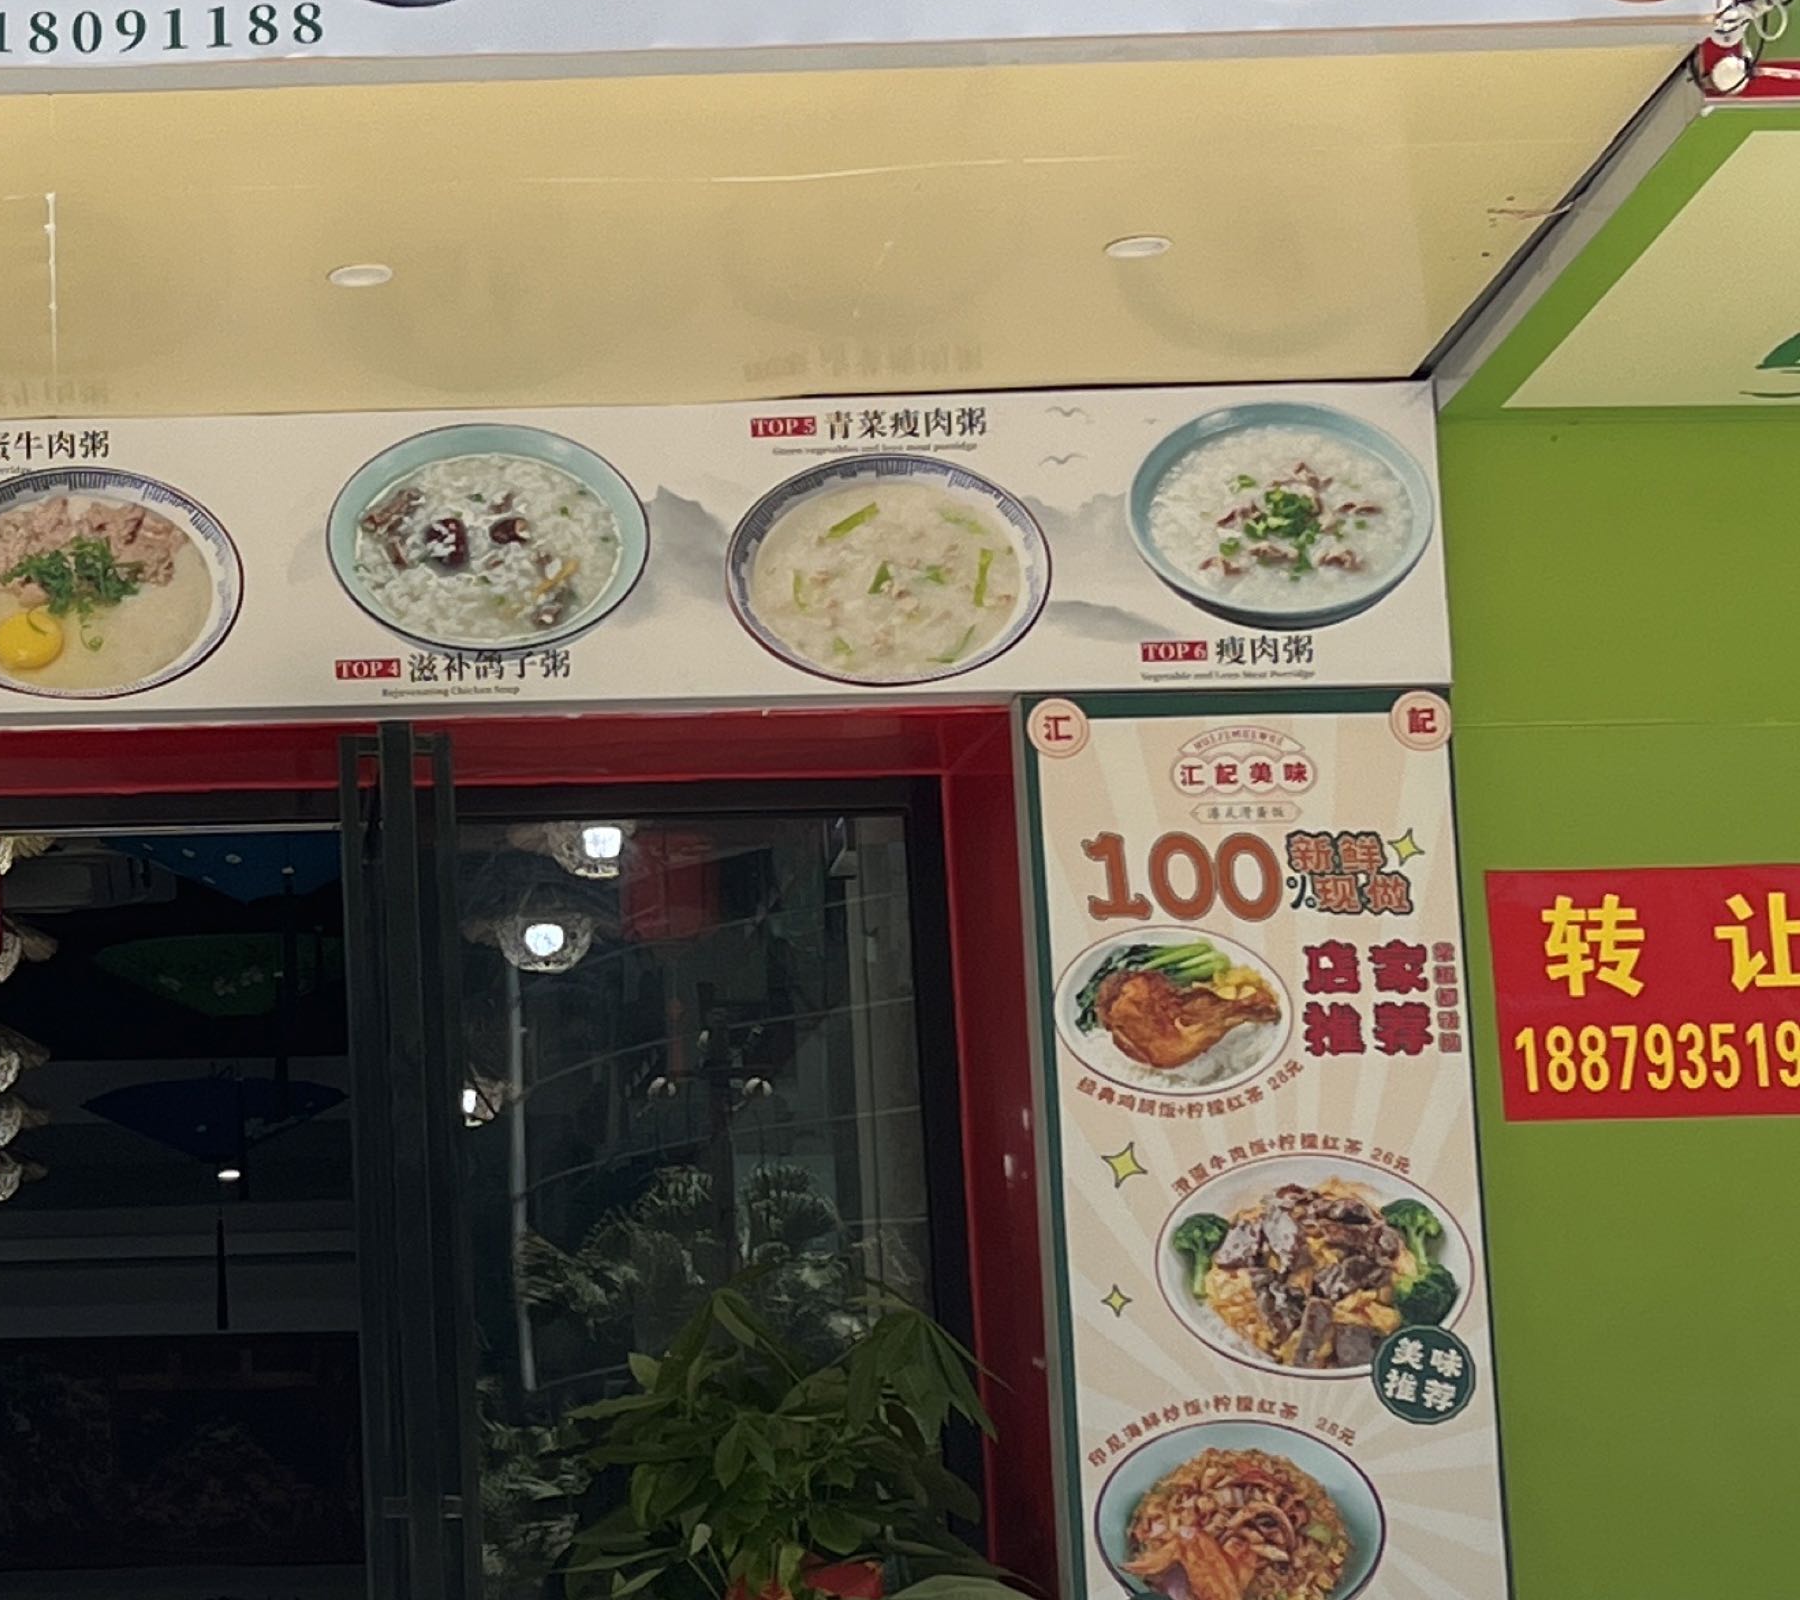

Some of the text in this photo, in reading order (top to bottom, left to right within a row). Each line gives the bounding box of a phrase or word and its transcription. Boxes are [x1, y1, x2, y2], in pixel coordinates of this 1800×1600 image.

[752, 418, 799, 436] TOP
[823, 406, 988, 440] 青菜瘦肉粥
[1142, 643, 1190, 661] TOP
[1215, 634, 1314, 665] 瘦肉粥
[337, 661, 384, 678] TOP
[1042, 715, 1073, 742] 汇
[1406, 706, 1438, 735] 記
[1179, 761, 1309, 787] 汇記美味
[1287, 830, 1386, 874] 新鲜
[1081, 830, 1284, 923] 100
[1313, 873, 1413, 914] 现做
[1541, 892, 1800, 998] 转让
[1390, 1336, 1464, 1378] 美味
[1384, 1367, 1458, 1412] 推荐
